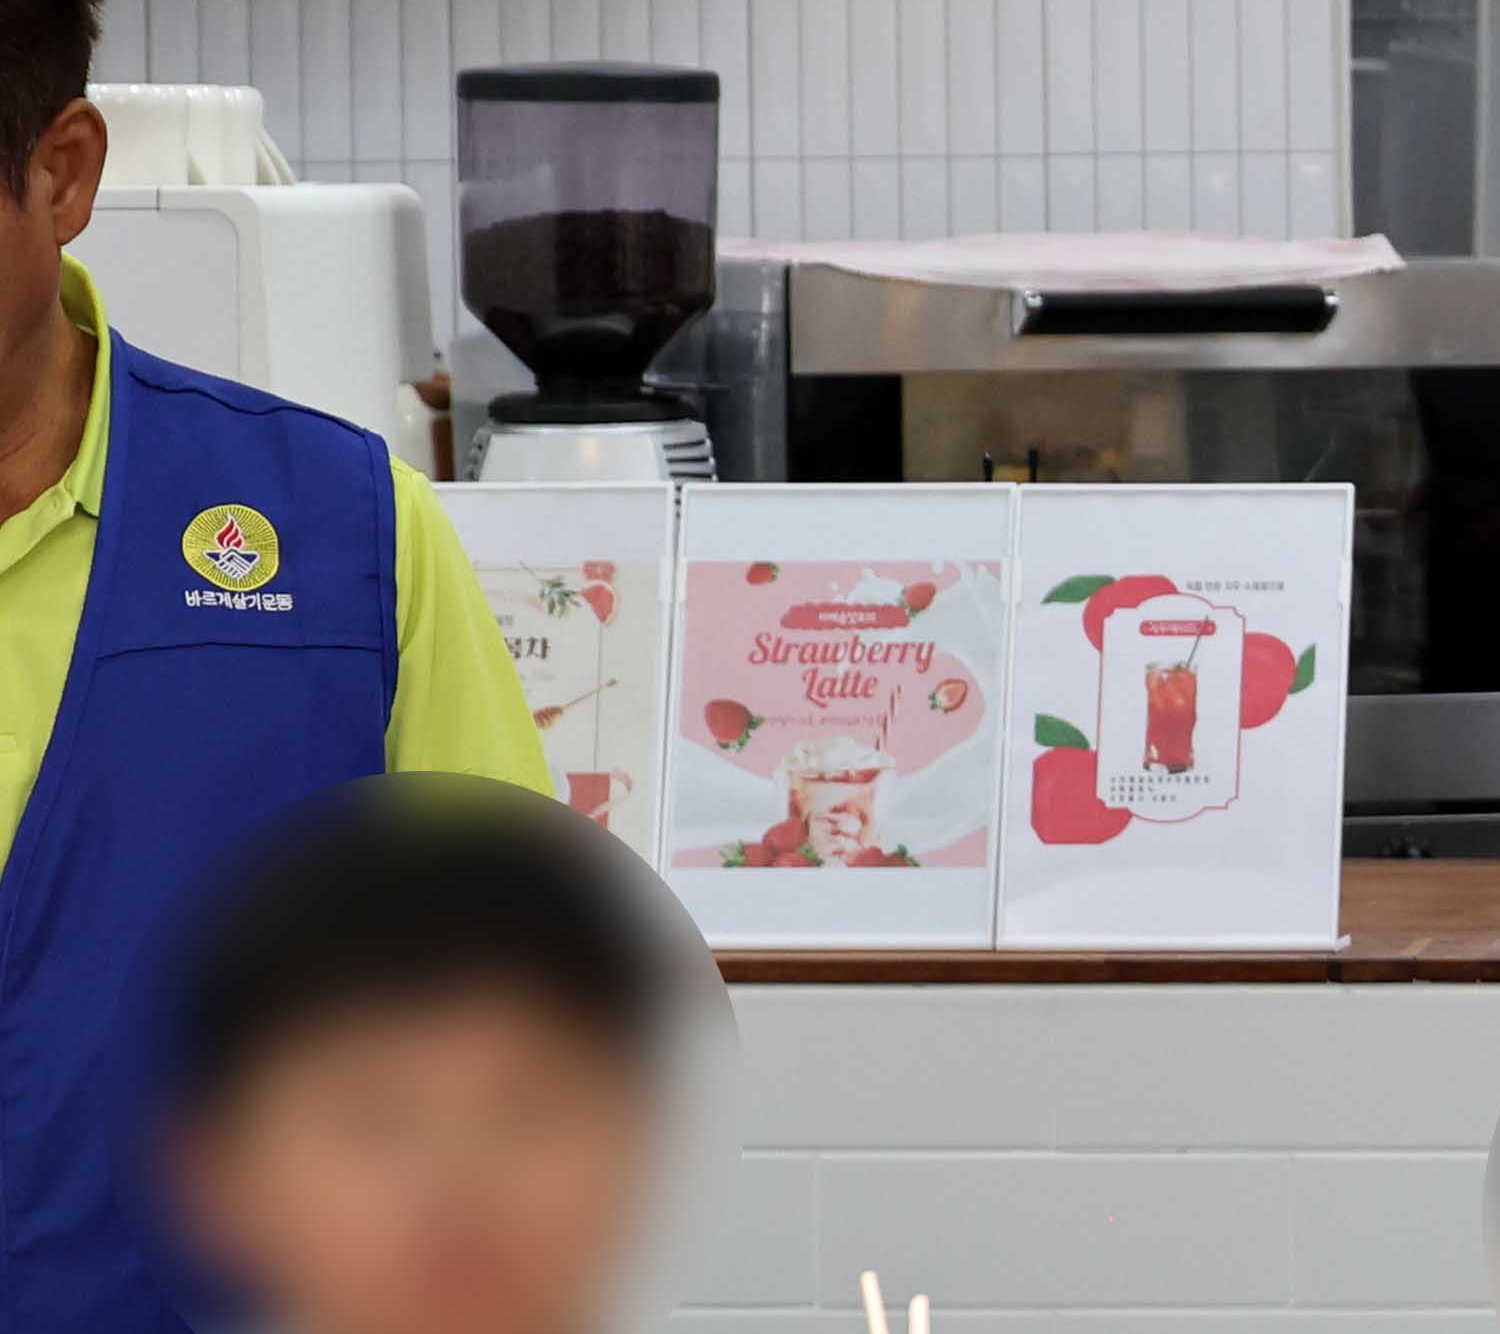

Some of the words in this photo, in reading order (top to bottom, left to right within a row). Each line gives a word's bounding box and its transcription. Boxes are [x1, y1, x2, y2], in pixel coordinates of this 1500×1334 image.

[185, 590, 293, 611] 바르게살기운동
[749, 632, 935, 674] Strawberry
[802, 668, 878, 708] Latte
